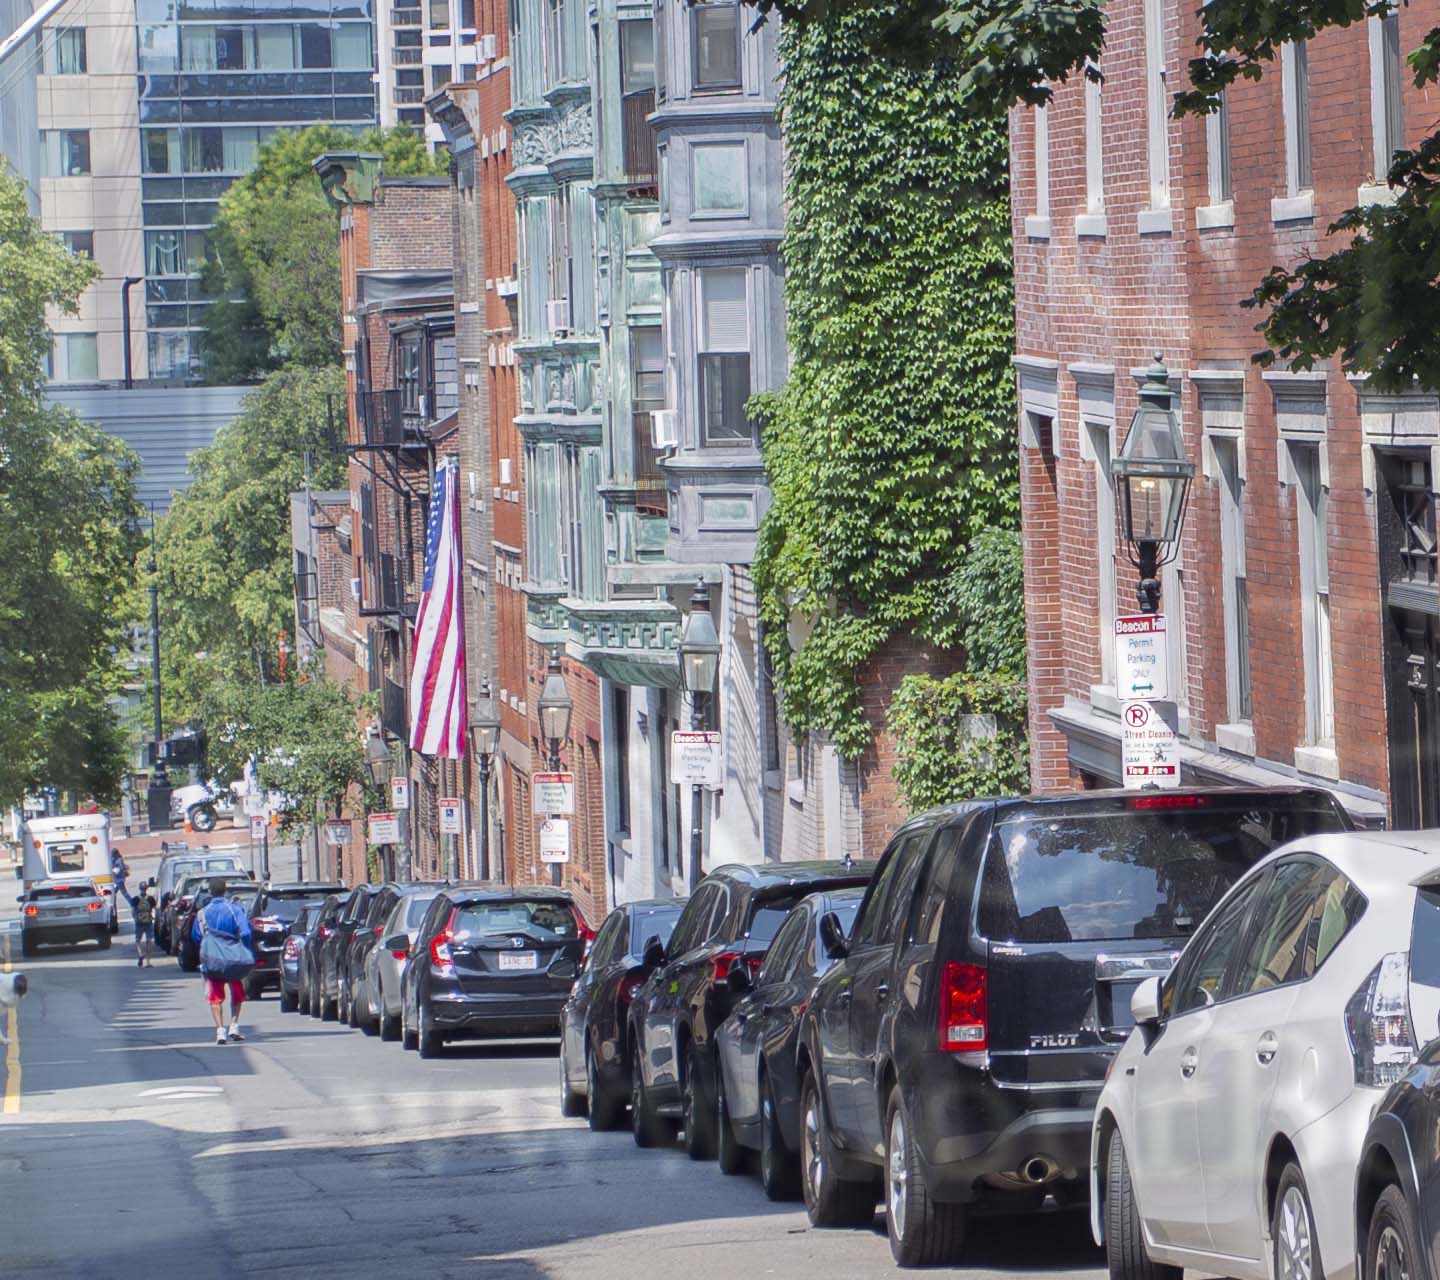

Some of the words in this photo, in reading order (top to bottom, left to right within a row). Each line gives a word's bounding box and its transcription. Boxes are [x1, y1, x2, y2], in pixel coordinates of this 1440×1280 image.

[1115, 620, 1149, 633] Beacon
[1128, 638, 1154, 648] Permit
[1127, 653, 1156, 665] Parking
[1125, 730, 1145, 739] Street
[1148, 730, 1176, 739] Cleaning
[1129, 767, 1145, 775] Tow
[1029, 1033, 1079, 1048] PILOT
